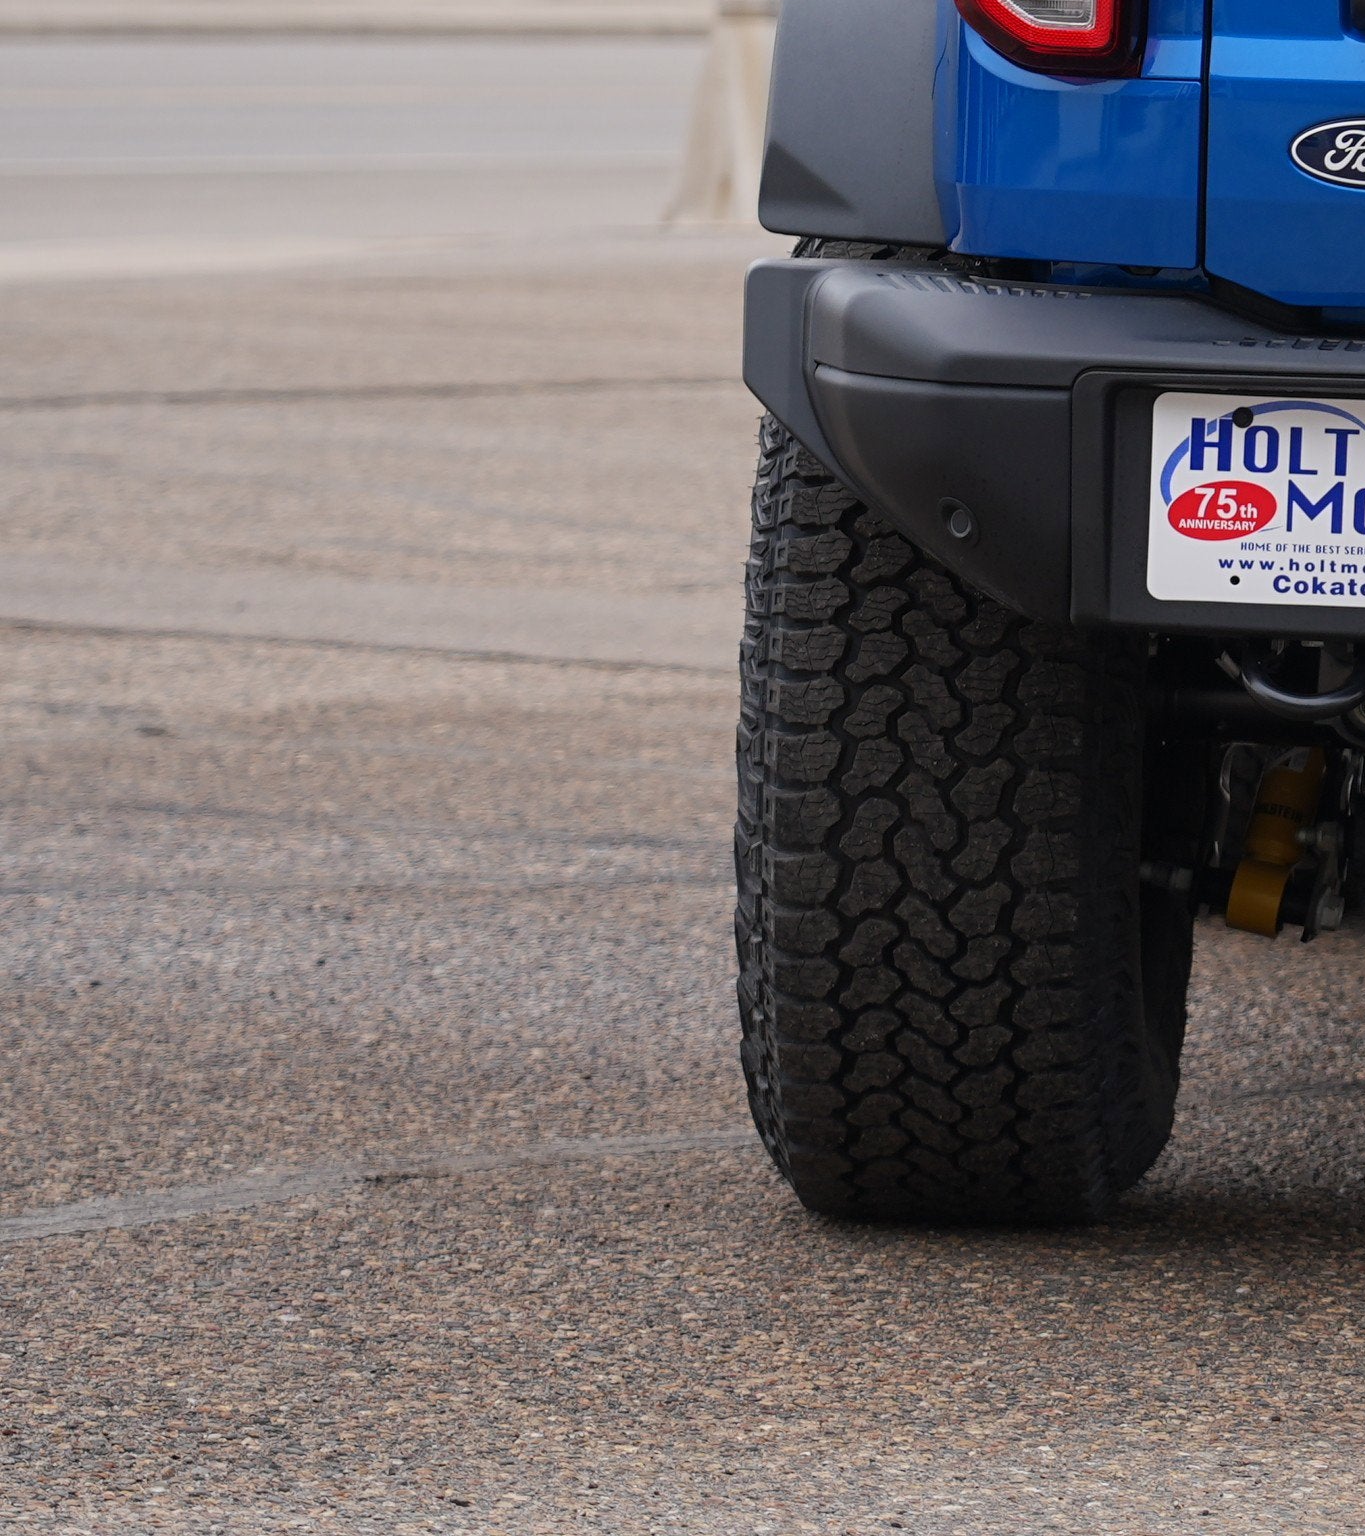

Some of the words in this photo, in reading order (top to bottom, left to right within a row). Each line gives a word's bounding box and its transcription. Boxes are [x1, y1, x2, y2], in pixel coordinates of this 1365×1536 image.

[1190, 417, 1360, 477] HOLT
[1194, 487, 1258, 519] 75th
[1178, 518, 1257, 531] ANNIVERSARY
[1240, 542, 1272, 552] HOME
[1275, 543, 1288, 553] OF
[1292, 544, 1311, 554] THE
[1315, 545, 1341, 555] BEST
